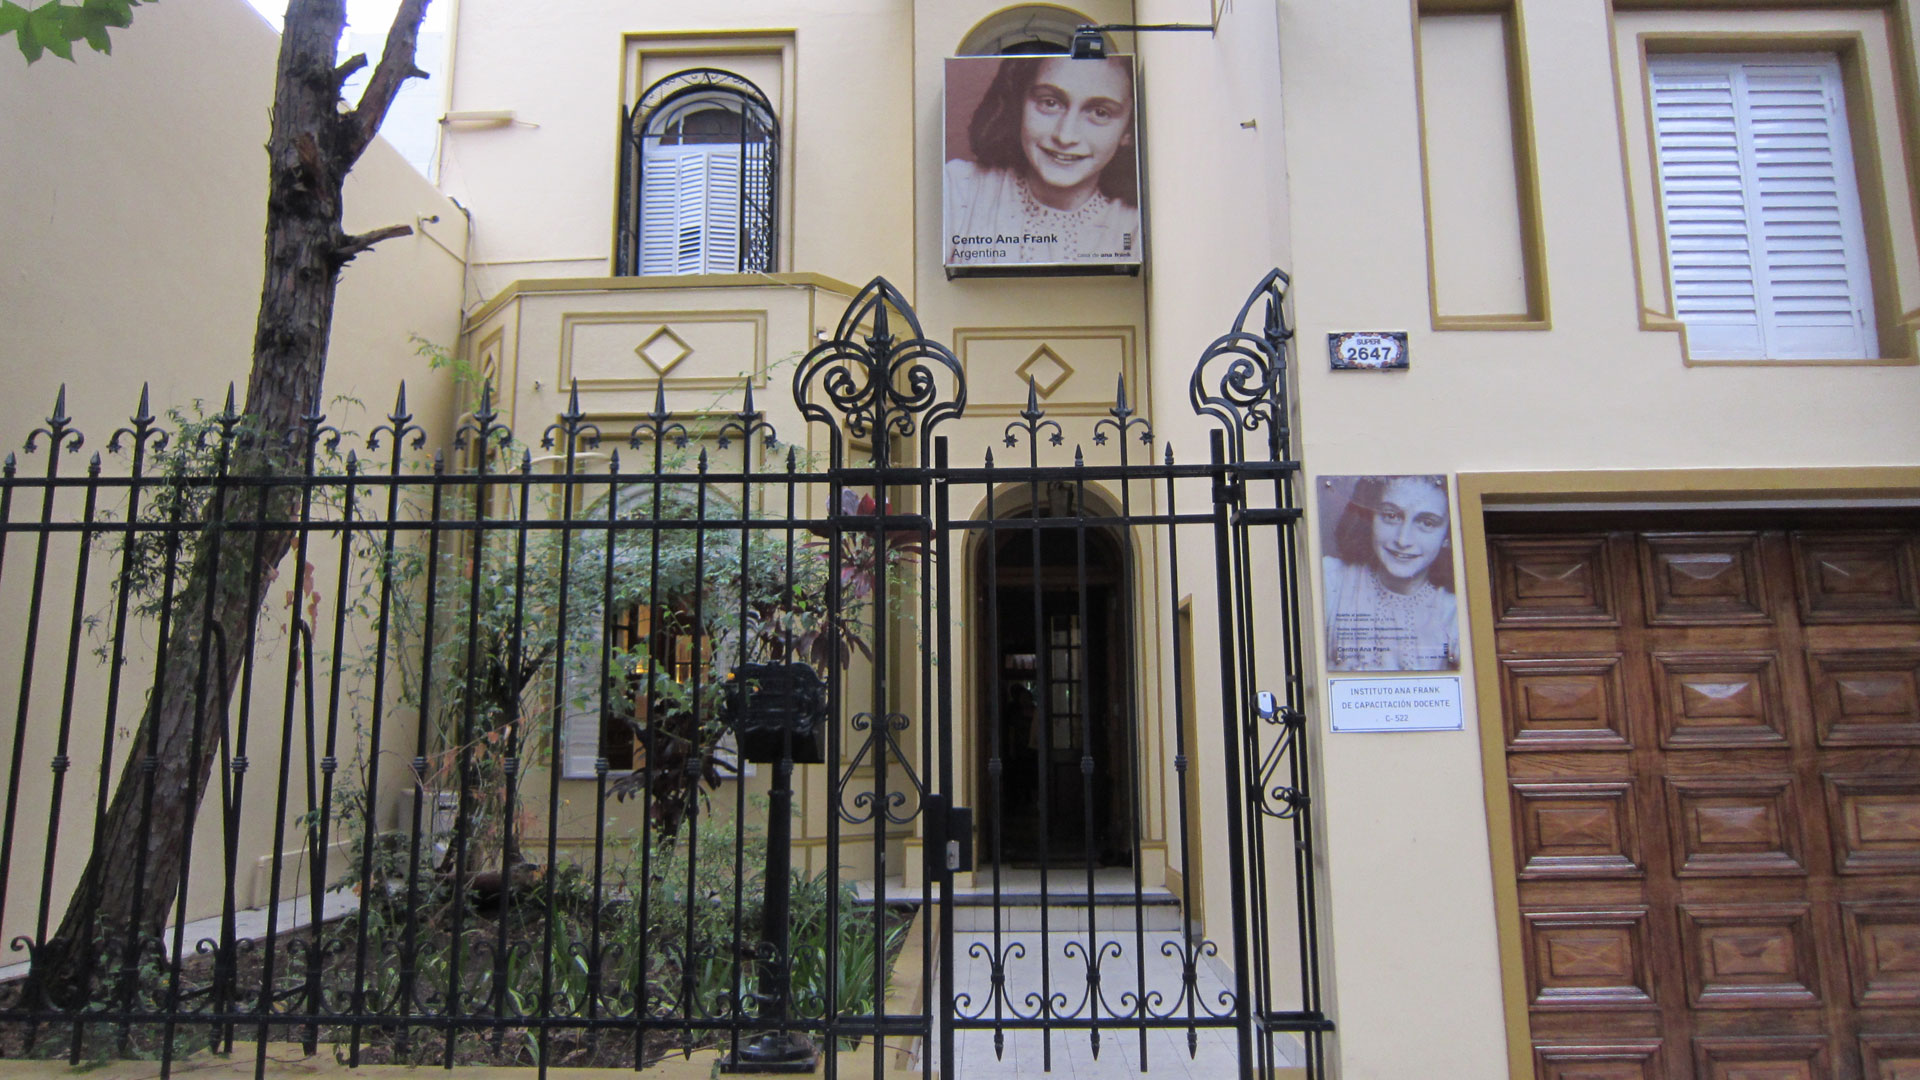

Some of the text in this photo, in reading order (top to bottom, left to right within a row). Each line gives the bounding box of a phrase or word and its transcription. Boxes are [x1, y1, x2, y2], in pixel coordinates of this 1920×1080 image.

[952, 233, 1058, 245] Centro Ana Frank
[952, 248, 1006, 260] Argentina
[1347, 347, 1391, 360] 2647
[1354, 700, 1412, 708] CAPACITACIÓN
[1414, 700, 1450, 708] DOCENTE
